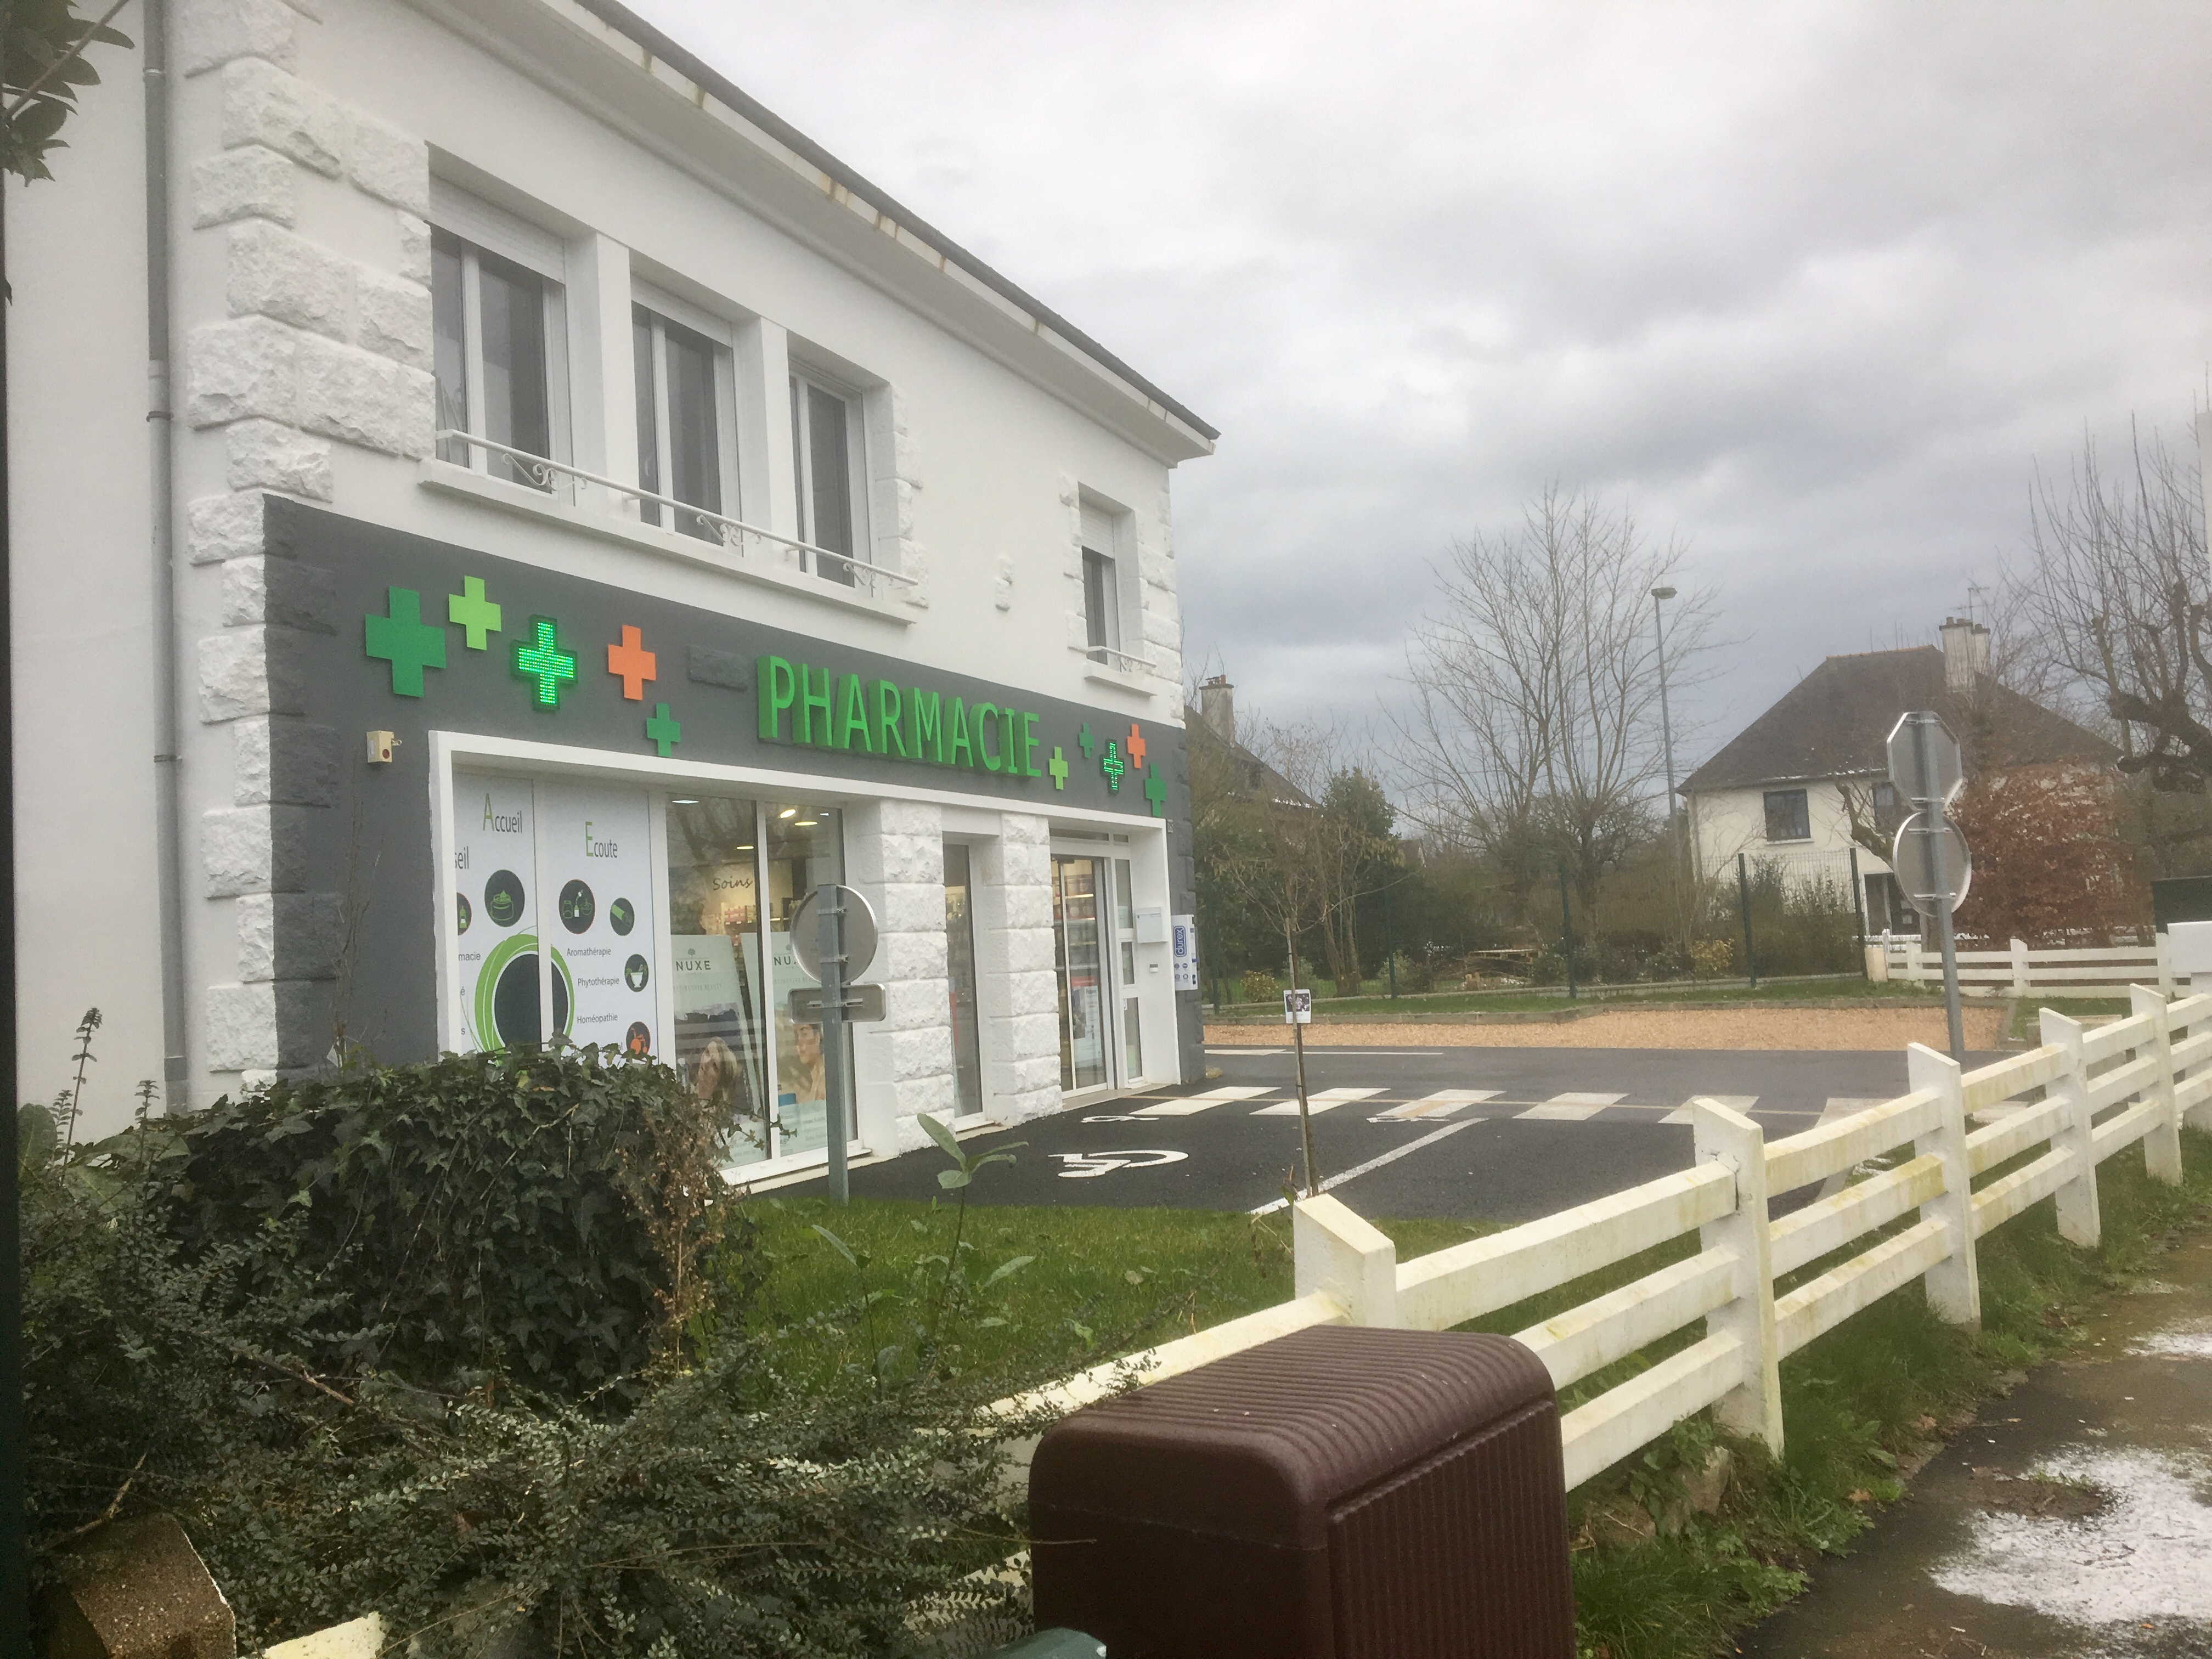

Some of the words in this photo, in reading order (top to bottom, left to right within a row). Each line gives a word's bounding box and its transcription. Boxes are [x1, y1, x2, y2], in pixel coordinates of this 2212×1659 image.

[757, 655, 1042, 777] PHARMACIE
[483, 793, 523, 833] Accueil
[585, 821, 618, 858] Ecoute
[713, 876, 753, 890] Soins
[1175, 928, 1184, 954] durex
[567, 947, 611, 957] Aromathérapie
[675, 961, 711, 971] NUXE
[578, 977, 619, 988] Phytothérapie
[577, 1013, 618, 1024] Homéopathie
